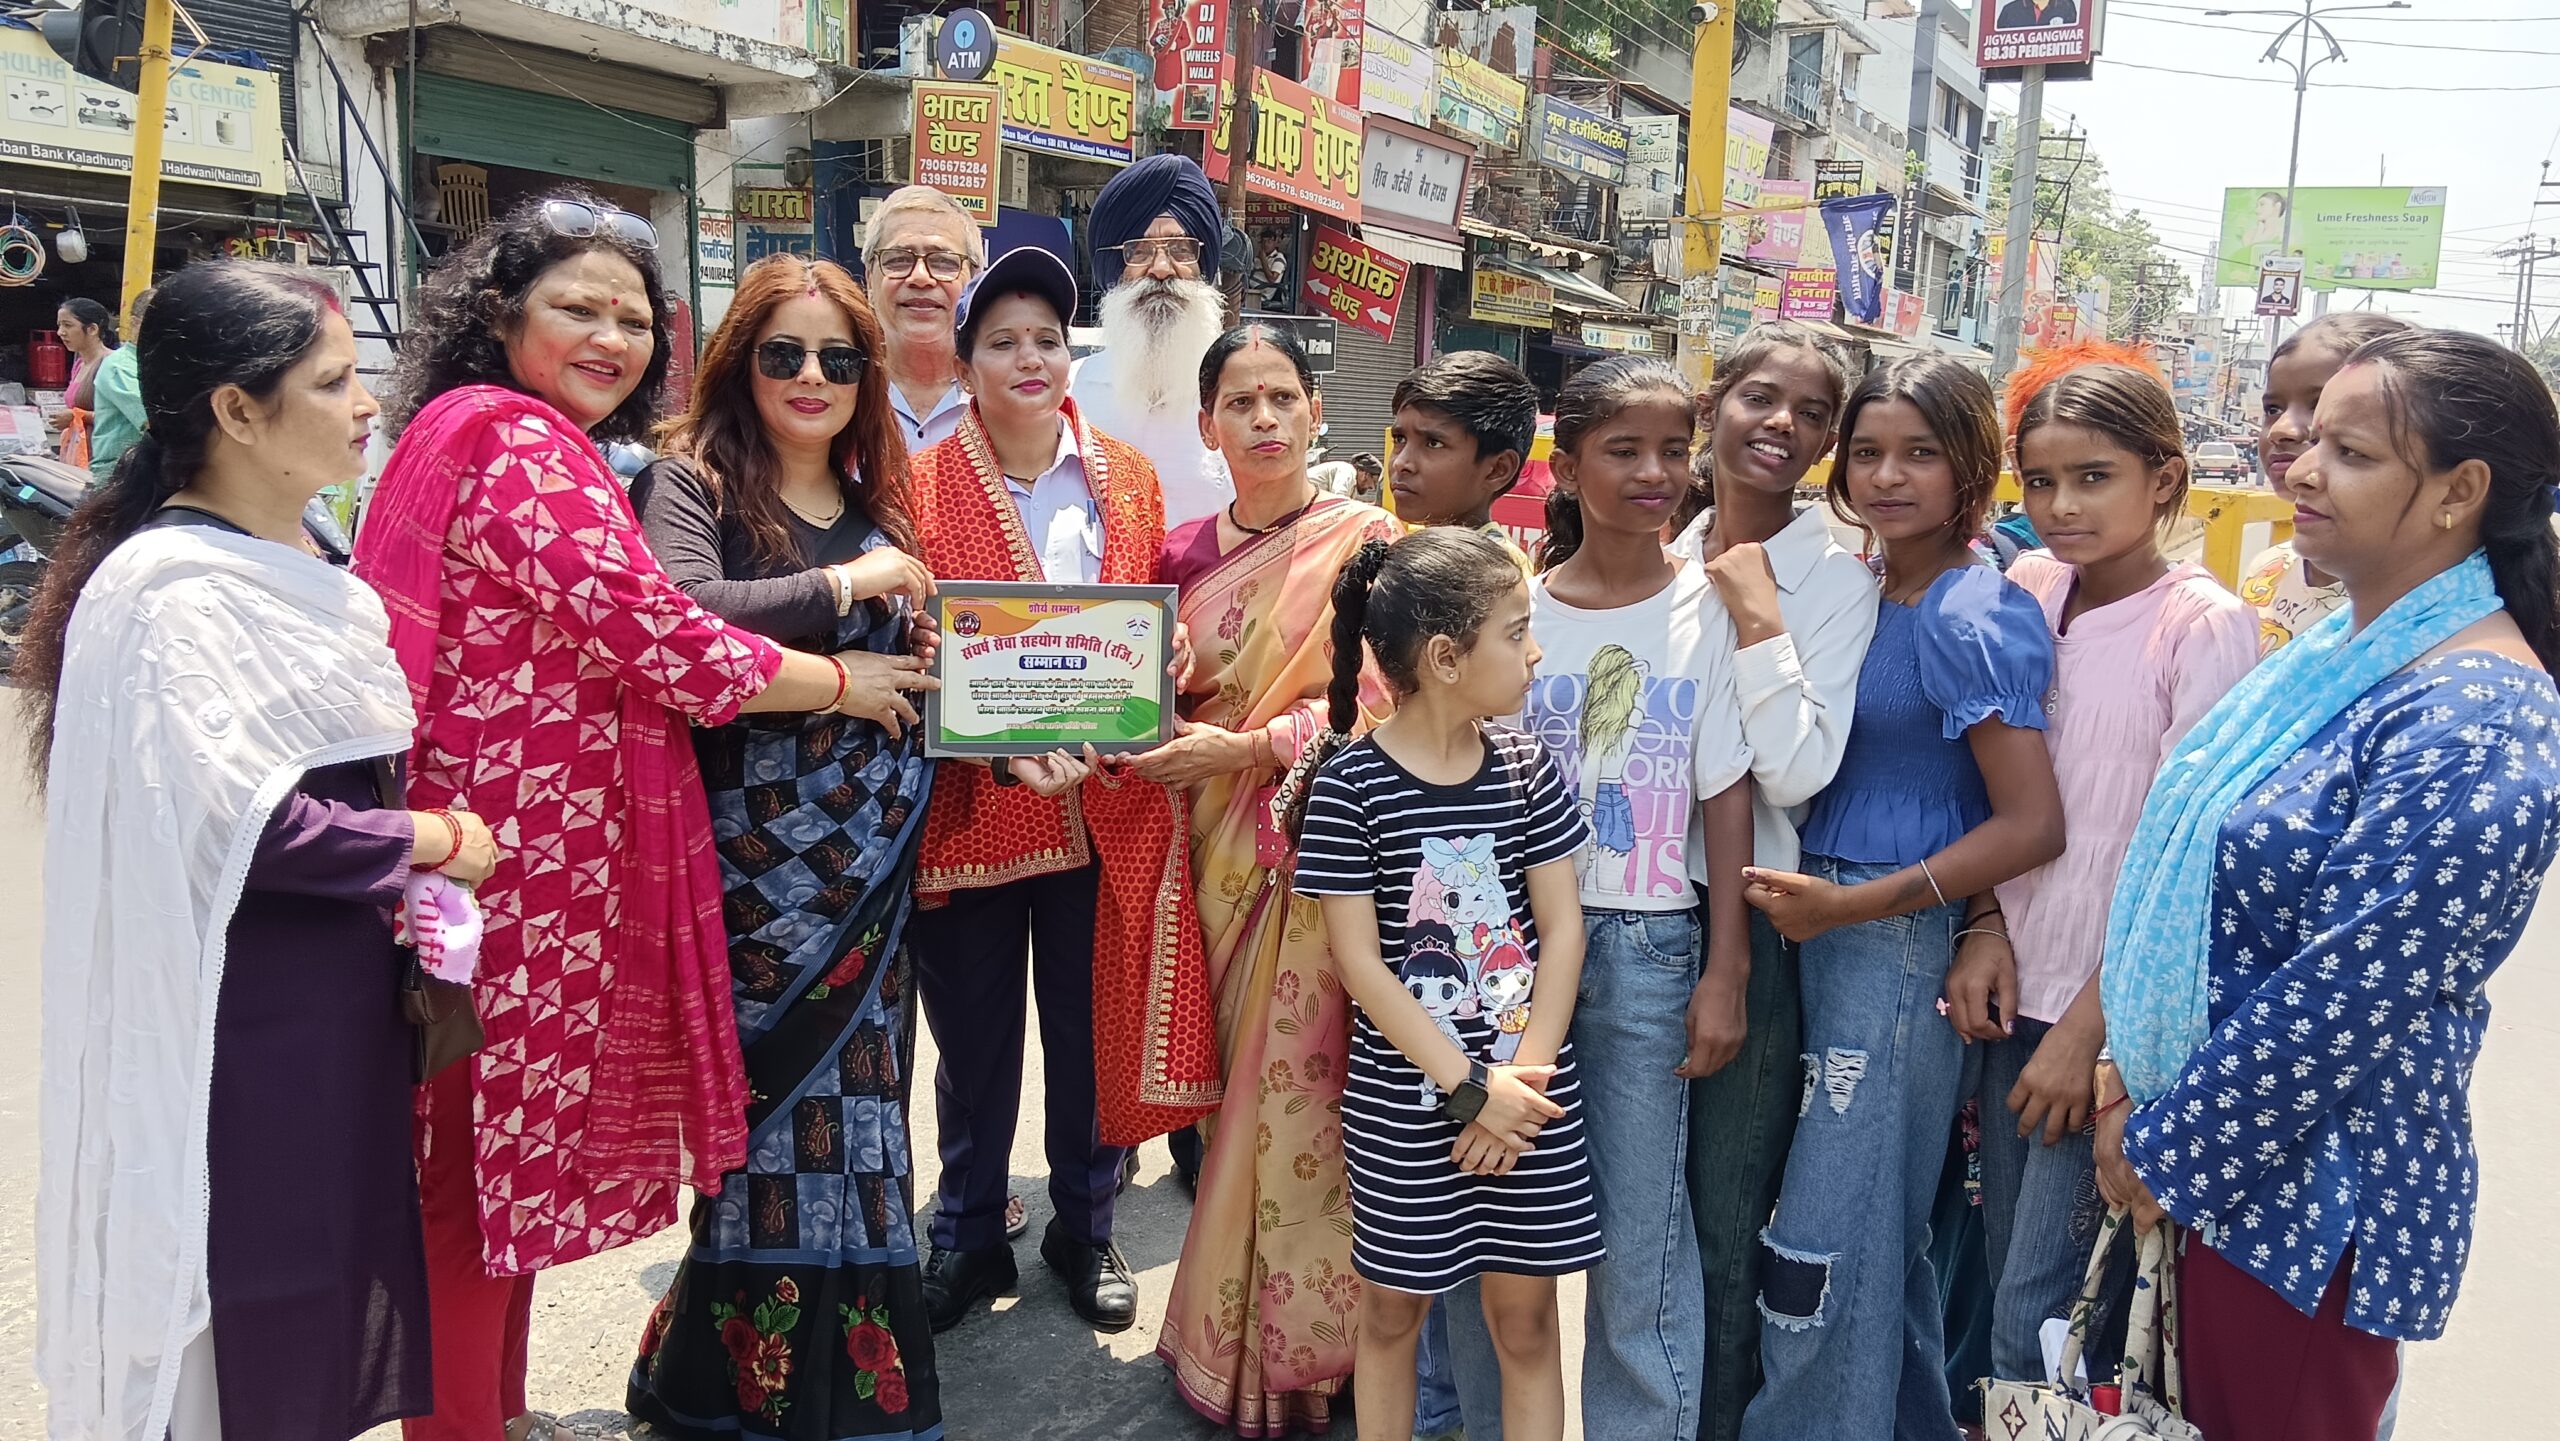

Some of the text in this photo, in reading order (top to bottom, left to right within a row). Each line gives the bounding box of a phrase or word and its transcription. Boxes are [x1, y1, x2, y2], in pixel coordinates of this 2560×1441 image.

[1199, 4, 1215, 22] DJ
[1196, 26, 1215, 44] ON
[1983, 29, 2084, 46] JIGYASA GANGWAR
[947, 51, 981, 69] ATM
[1186, 50, 1220, 63] WHEELS
[1382, 38, 1411, 67] BAND
[1983, 41, 2082, 60] 99.36 PERCENTILE
[1189, 66, 1214, 79] WALA
[189, 82, 257, 109] CENTRE
[1060, 60, 1132, 141] बैण्ड
[923, 94, 991, 123] भारत
[928, 121, 981, 157] बैण्ड
[1310, 96, 1361, 195] बैण्ड
[31, 144, 64, 160] Bank
[67, 150, 132, 170] Kaladhungi
[920, 159, 987, 175] 7906675284
[165, 162, 260, 187] Haldwani(Nainital)
[920, 172, 987, 189] 6395182857
[740, 190, 806, 219] भारत
[2317, 212, 2429, 224] Lime Freshness Soap
[1311, 241, 1400, 297] अशोक
[1329, 283, 1363, 321] बैण्ड
[1051, 604, 1080, 613] सम्मान
[961, 637, 990, 660] संघर्ष
[993, 636, 1016, 651] सेवा
[1020, 632, 1061, 648] सहयोग
[1066, 634, 1102, 653] समिति
[1023, 656, 1081, 669] सम्मान पत्र
